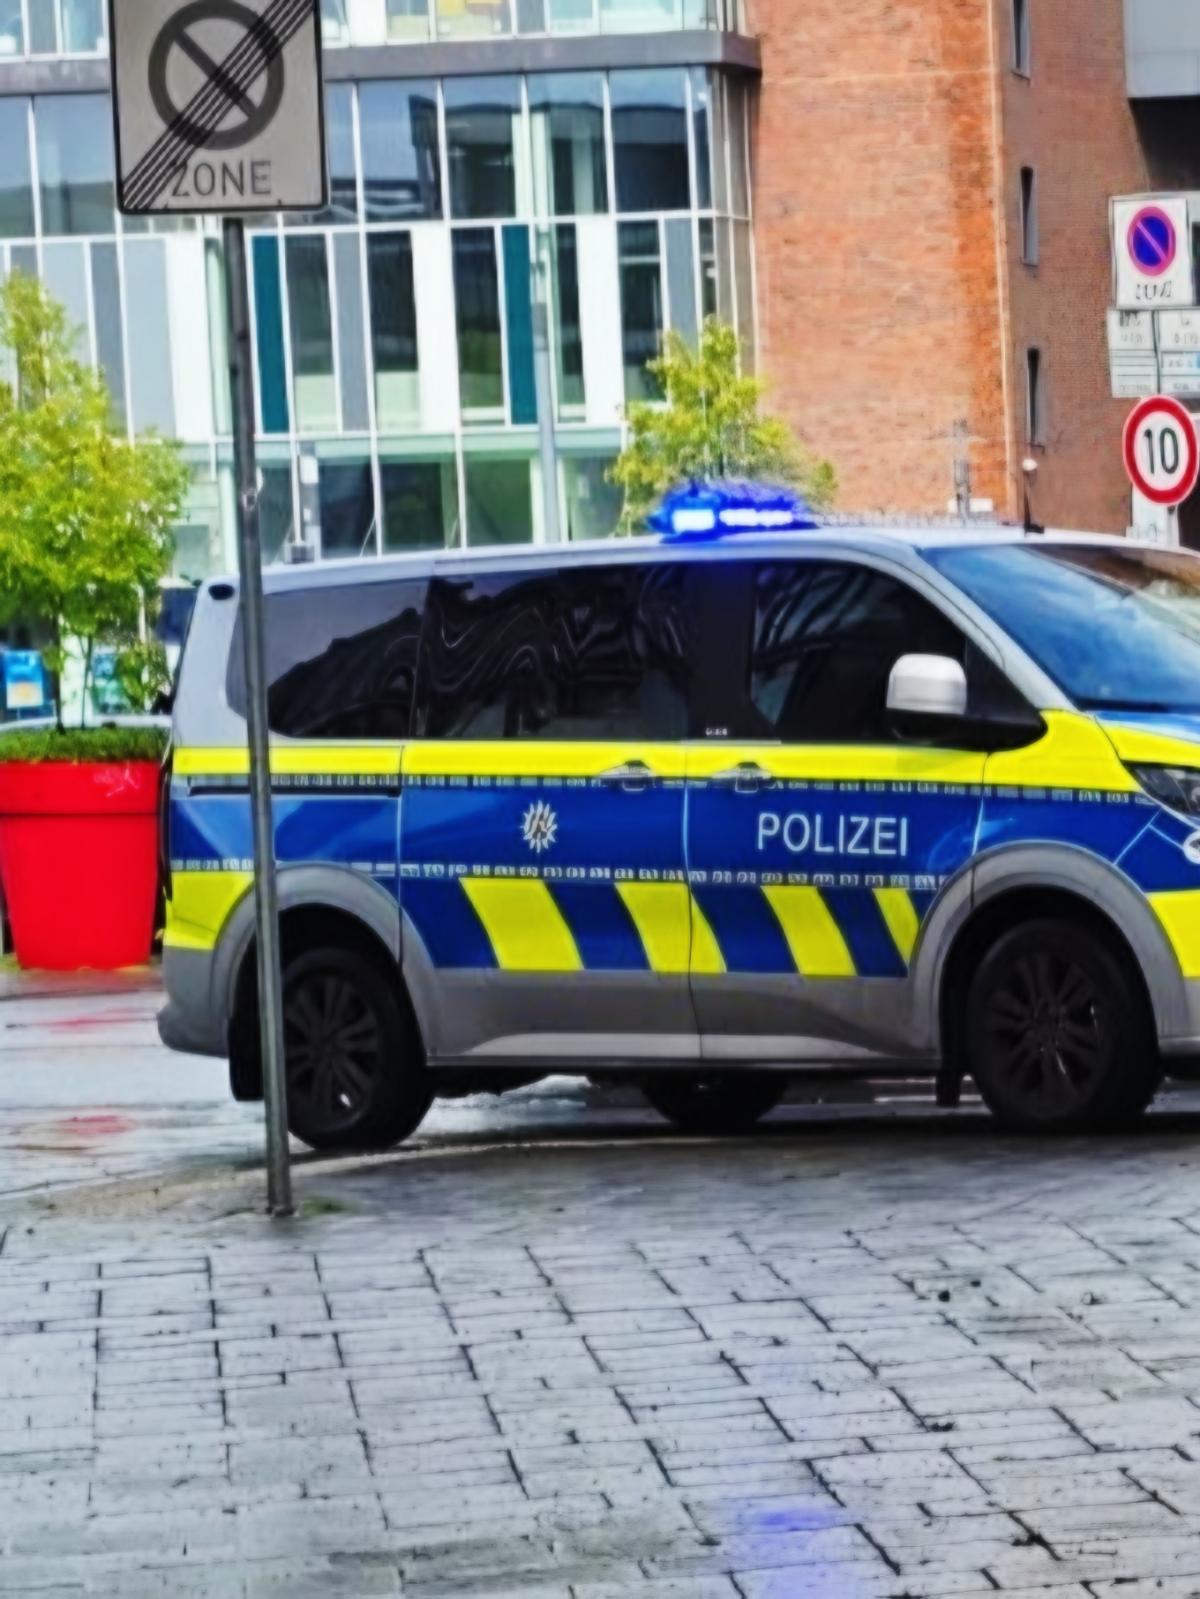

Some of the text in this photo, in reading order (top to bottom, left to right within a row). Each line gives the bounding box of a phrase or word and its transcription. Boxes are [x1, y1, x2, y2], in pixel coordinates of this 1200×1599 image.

[172, 160, 271, 197] ZONE
[1144, 427, 1179, 474] 10
[757, 811, 908, 857] POLIZEI
